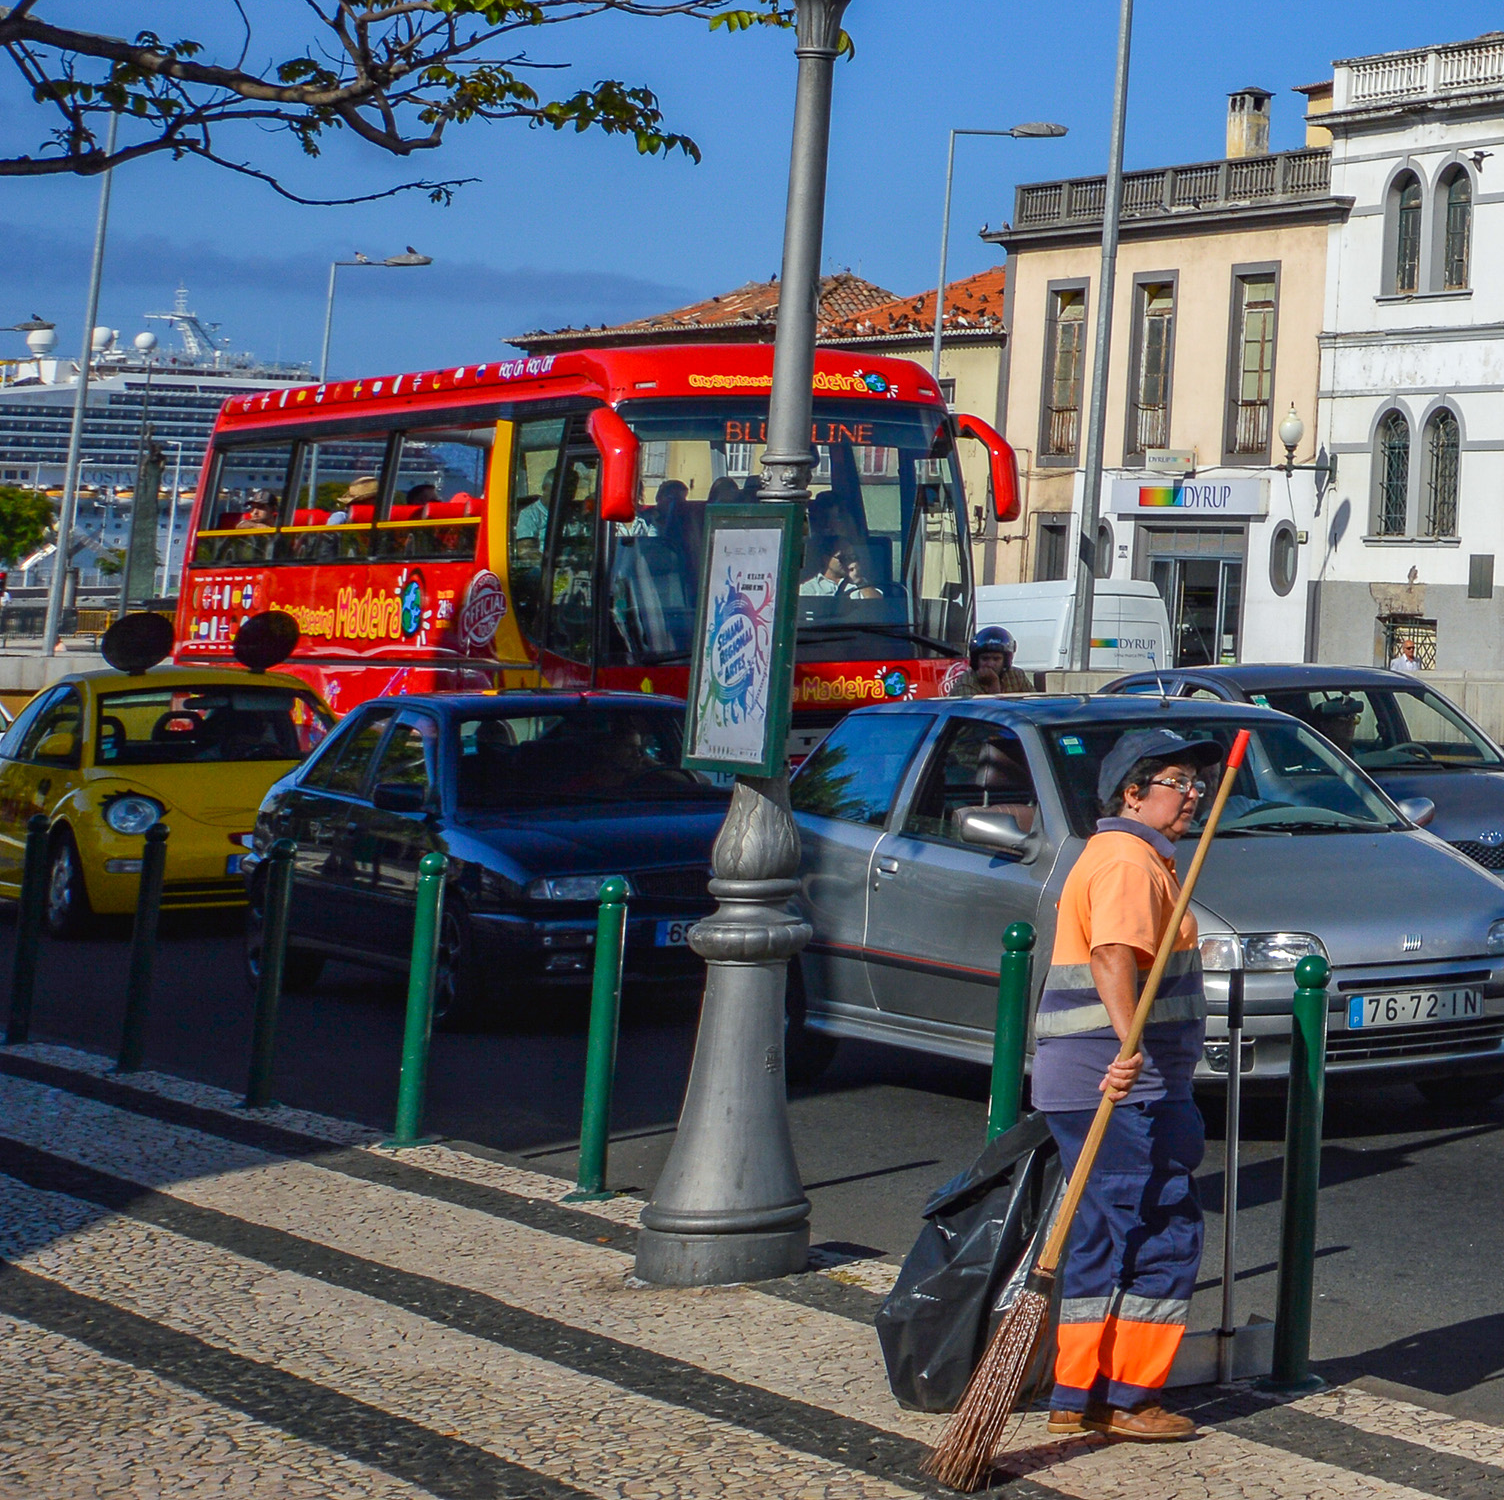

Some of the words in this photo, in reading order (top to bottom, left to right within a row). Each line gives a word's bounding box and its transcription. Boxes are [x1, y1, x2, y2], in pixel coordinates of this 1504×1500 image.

[812, 372, 868, 392] deira
[811, 423, 874, 445] LINE
[1148, 456, 1171, 464] DYRUP
[82, 470, 133, 485] COSTA
[1184, 485, 1231, 509] DYRUP
[335, 586, 402, 640] Madeira
[464, 595, 505, 633] OFFICIAL
[1119, 638, 1157, 650] DYRUP
[802, 675, 886, 701] Madeira
